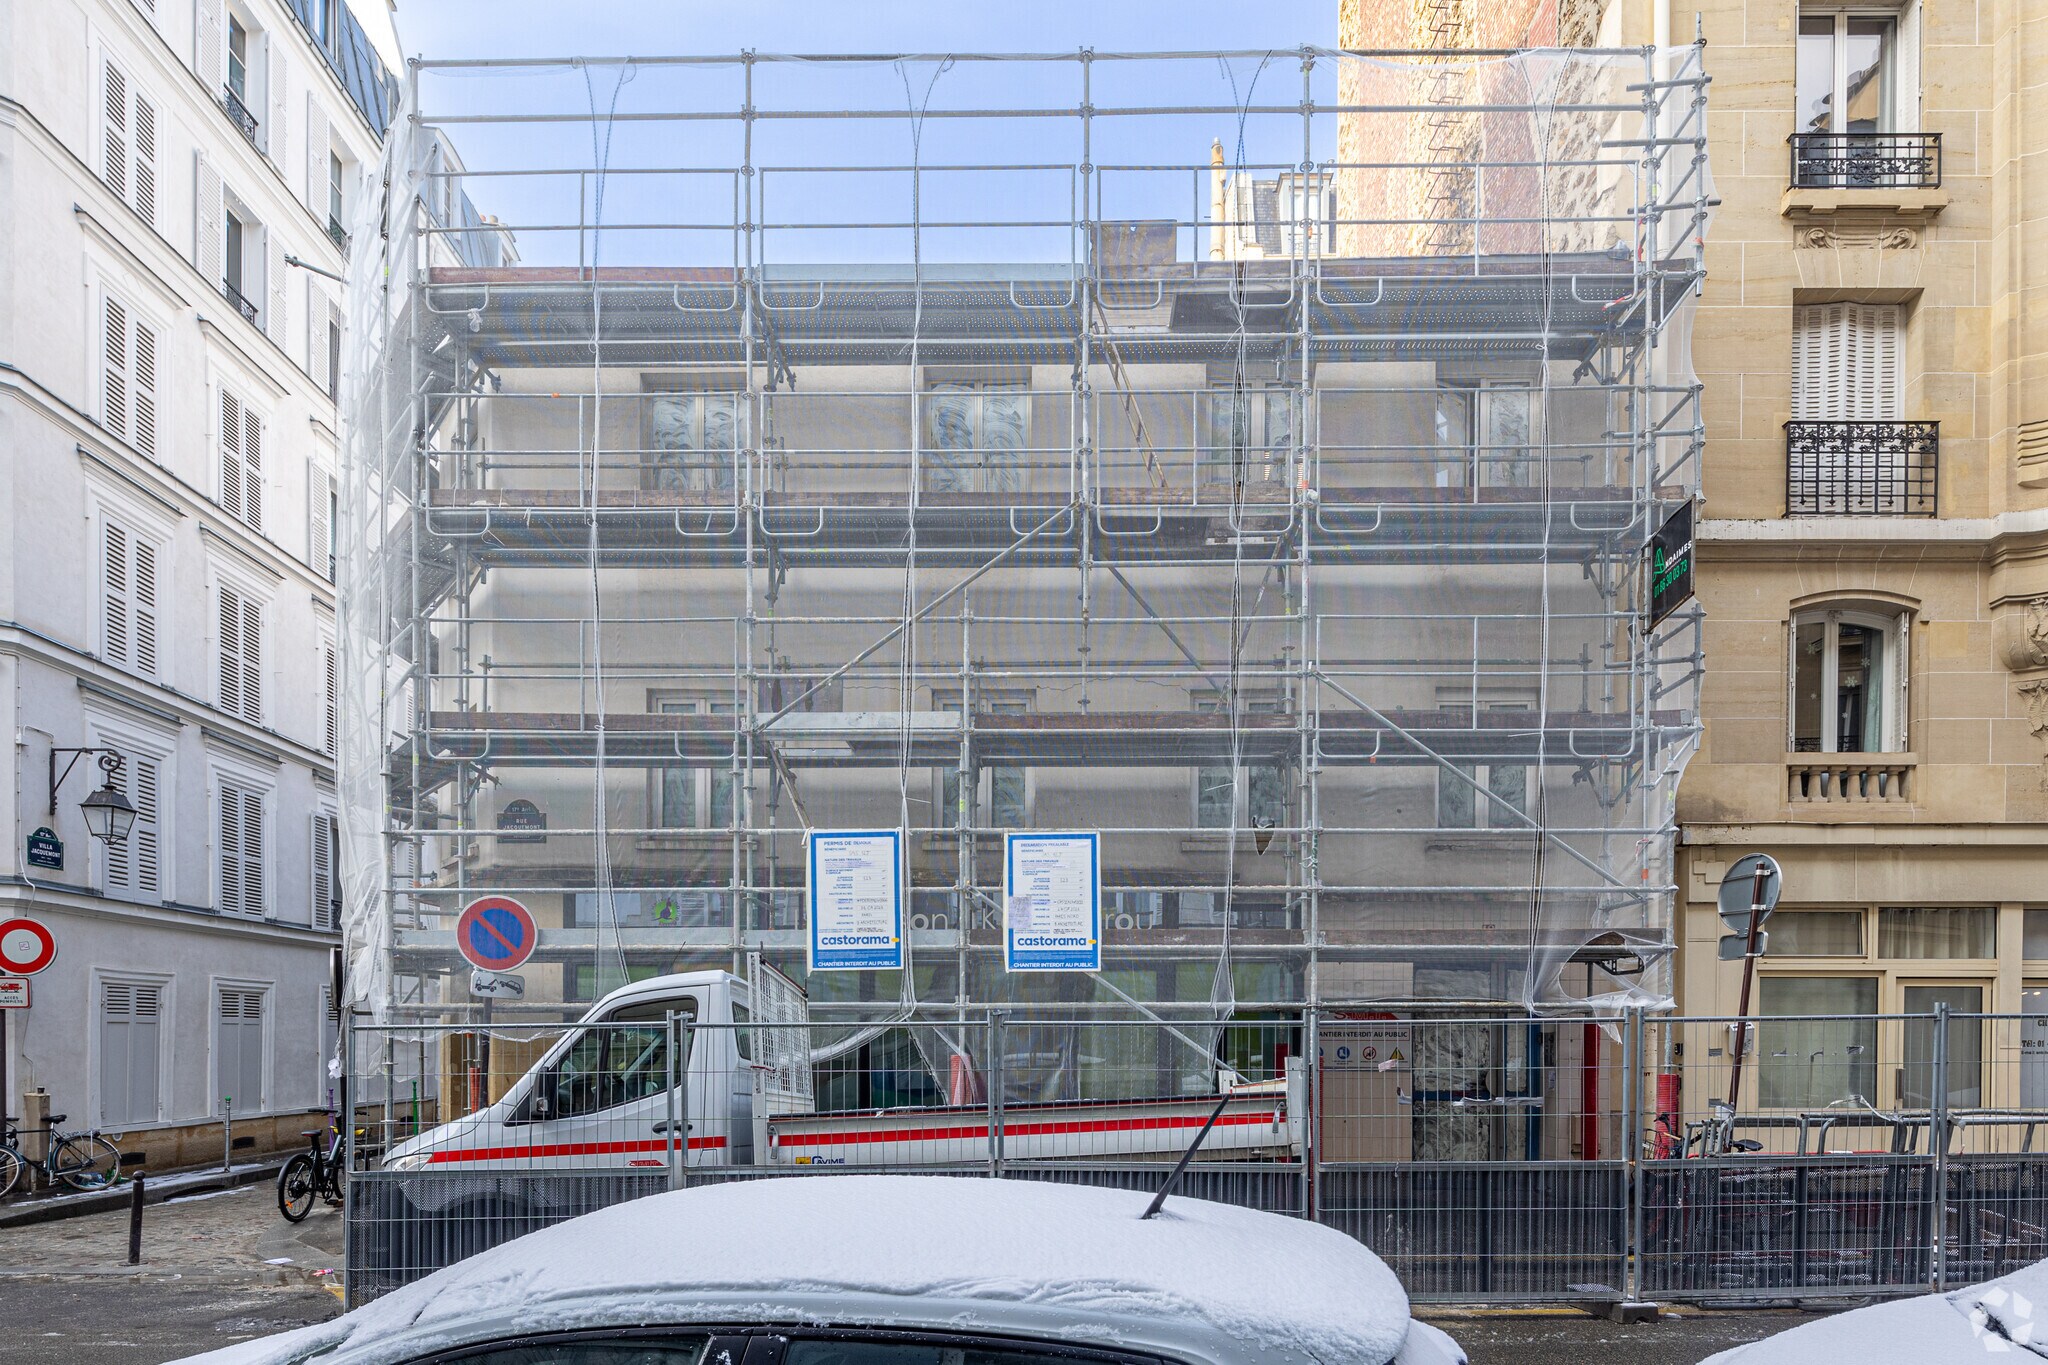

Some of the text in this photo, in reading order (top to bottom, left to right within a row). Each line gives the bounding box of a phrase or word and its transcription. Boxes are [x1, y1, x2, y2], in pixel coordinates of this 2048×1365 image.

[31, 848, 60, 858] JACQUEMONT
[822, 935, 890, 945] castorama
[1018, 936, 1086, 946] castorama
